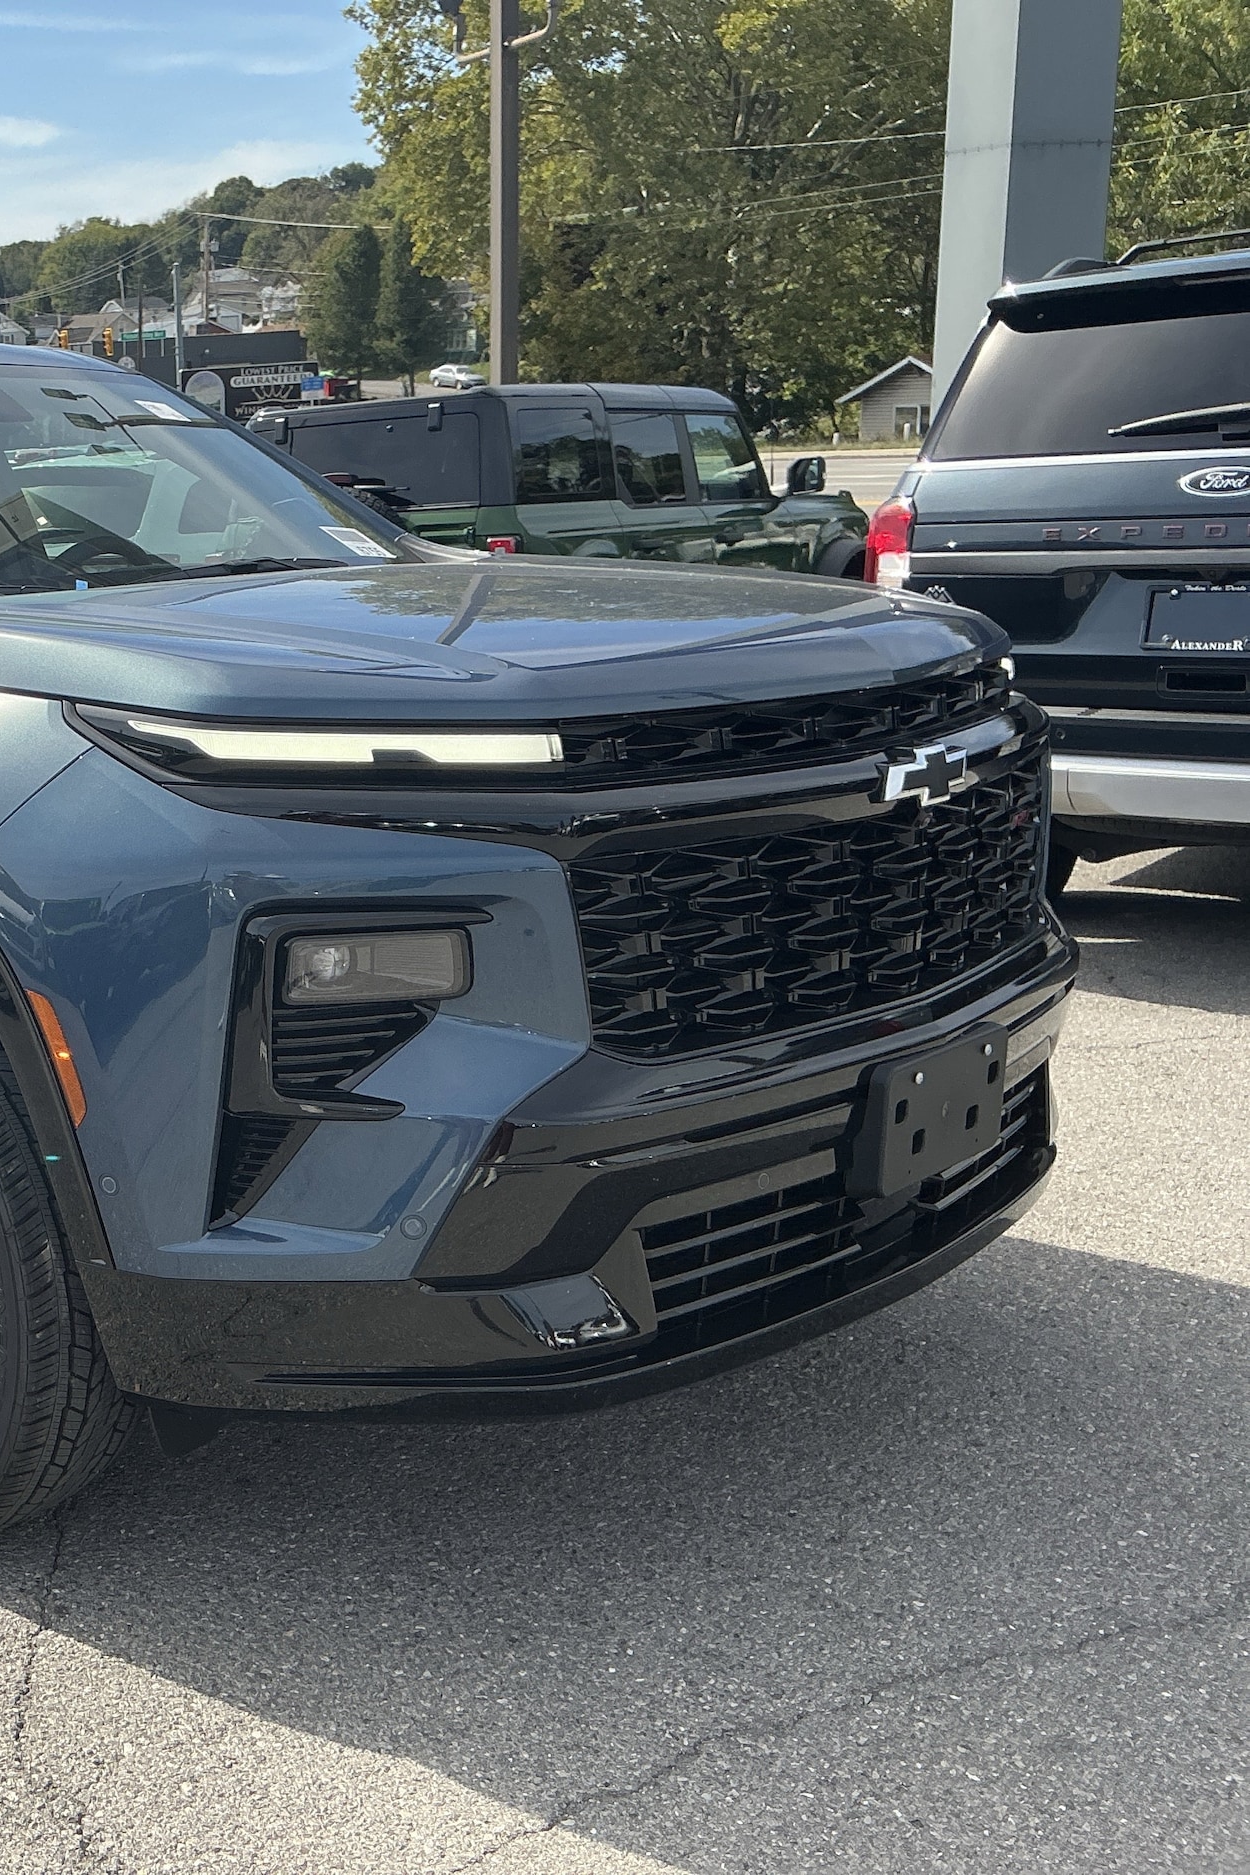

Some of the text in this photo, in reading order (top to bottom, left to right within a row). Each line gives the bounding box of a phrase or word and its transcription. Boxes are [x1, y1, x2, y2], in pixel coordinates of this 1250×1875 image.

[240, 365, 304, 376] LOWEST PRICE
[1200, 472, 1249, 489] Ford
[1170, 640, 1244, 651] ALEXANDER
